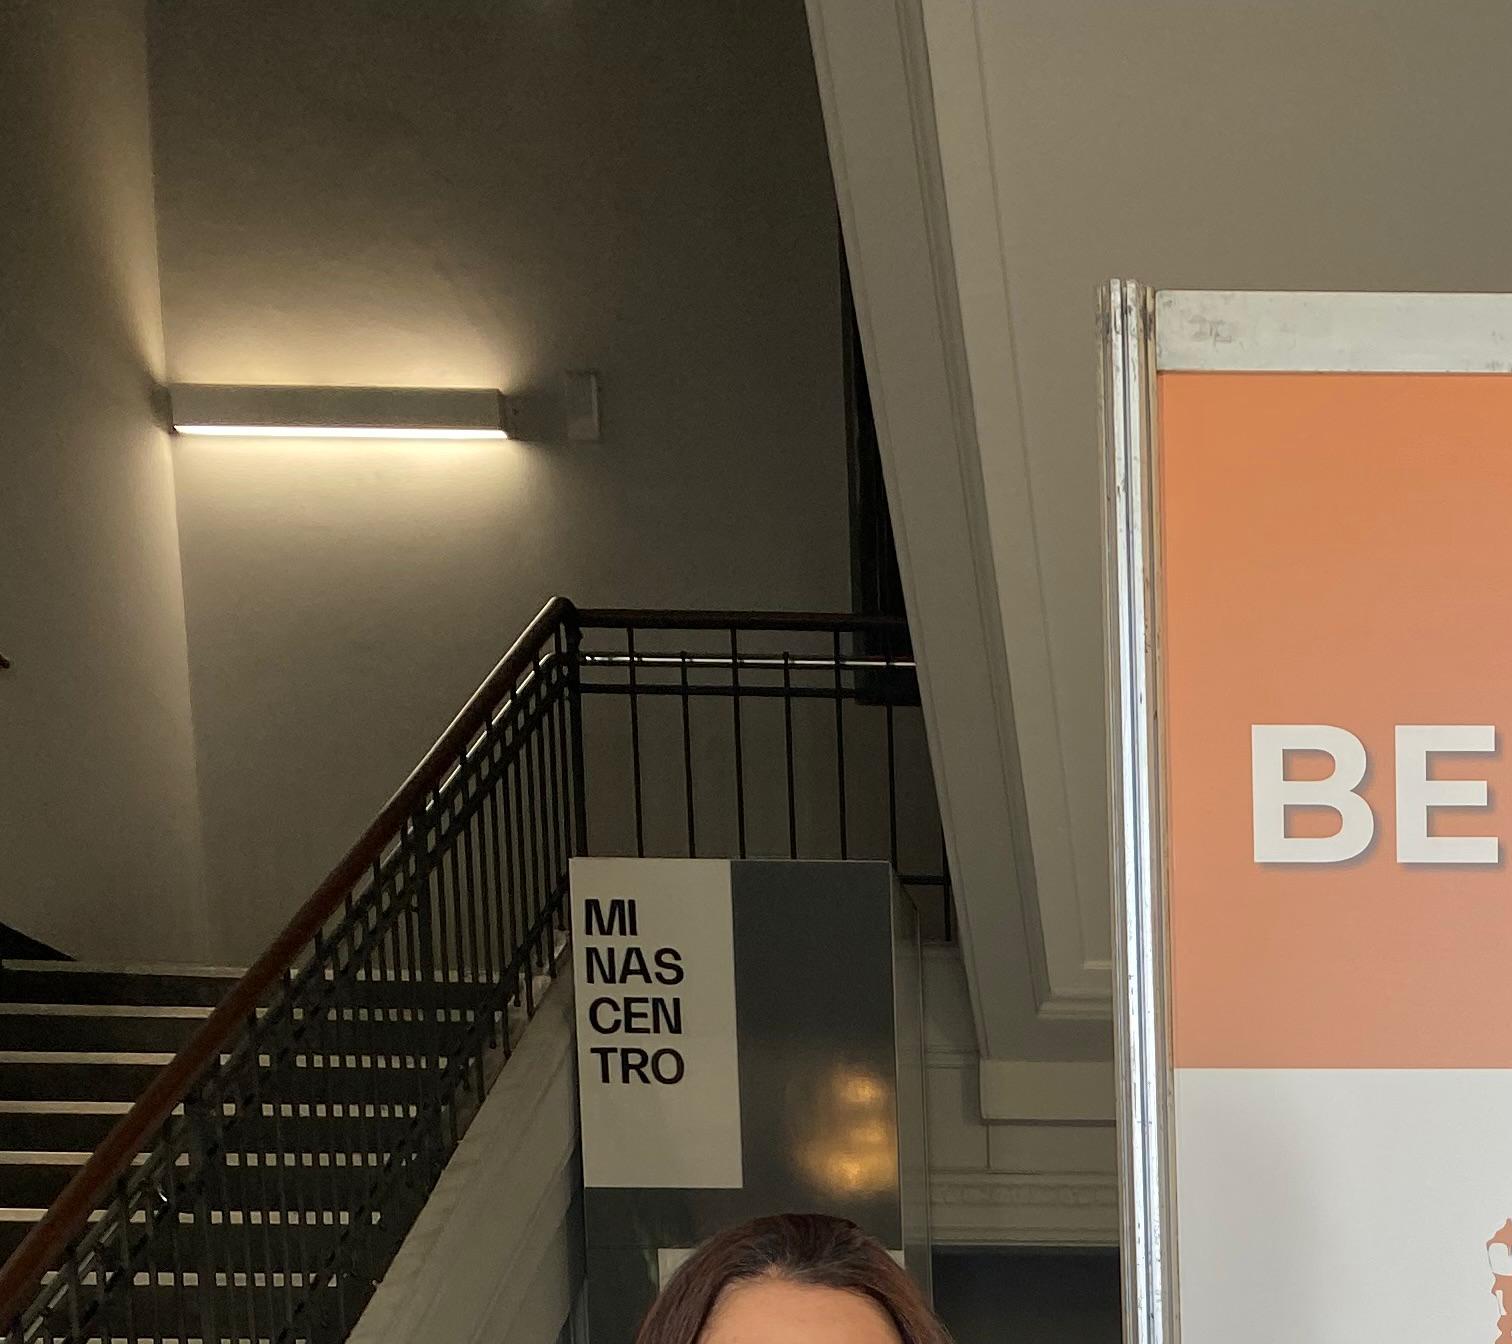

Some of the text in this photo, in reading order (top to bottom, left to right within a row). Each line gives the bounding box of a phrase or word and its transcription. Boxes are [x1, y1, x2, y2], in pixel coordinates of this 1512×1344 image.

[585, 898, 639, 937] MI
[586, 946, 685, 986] NAS
[588, 996, 683, 1036] CEN
[590, 1047, 685, 1085] TRO
